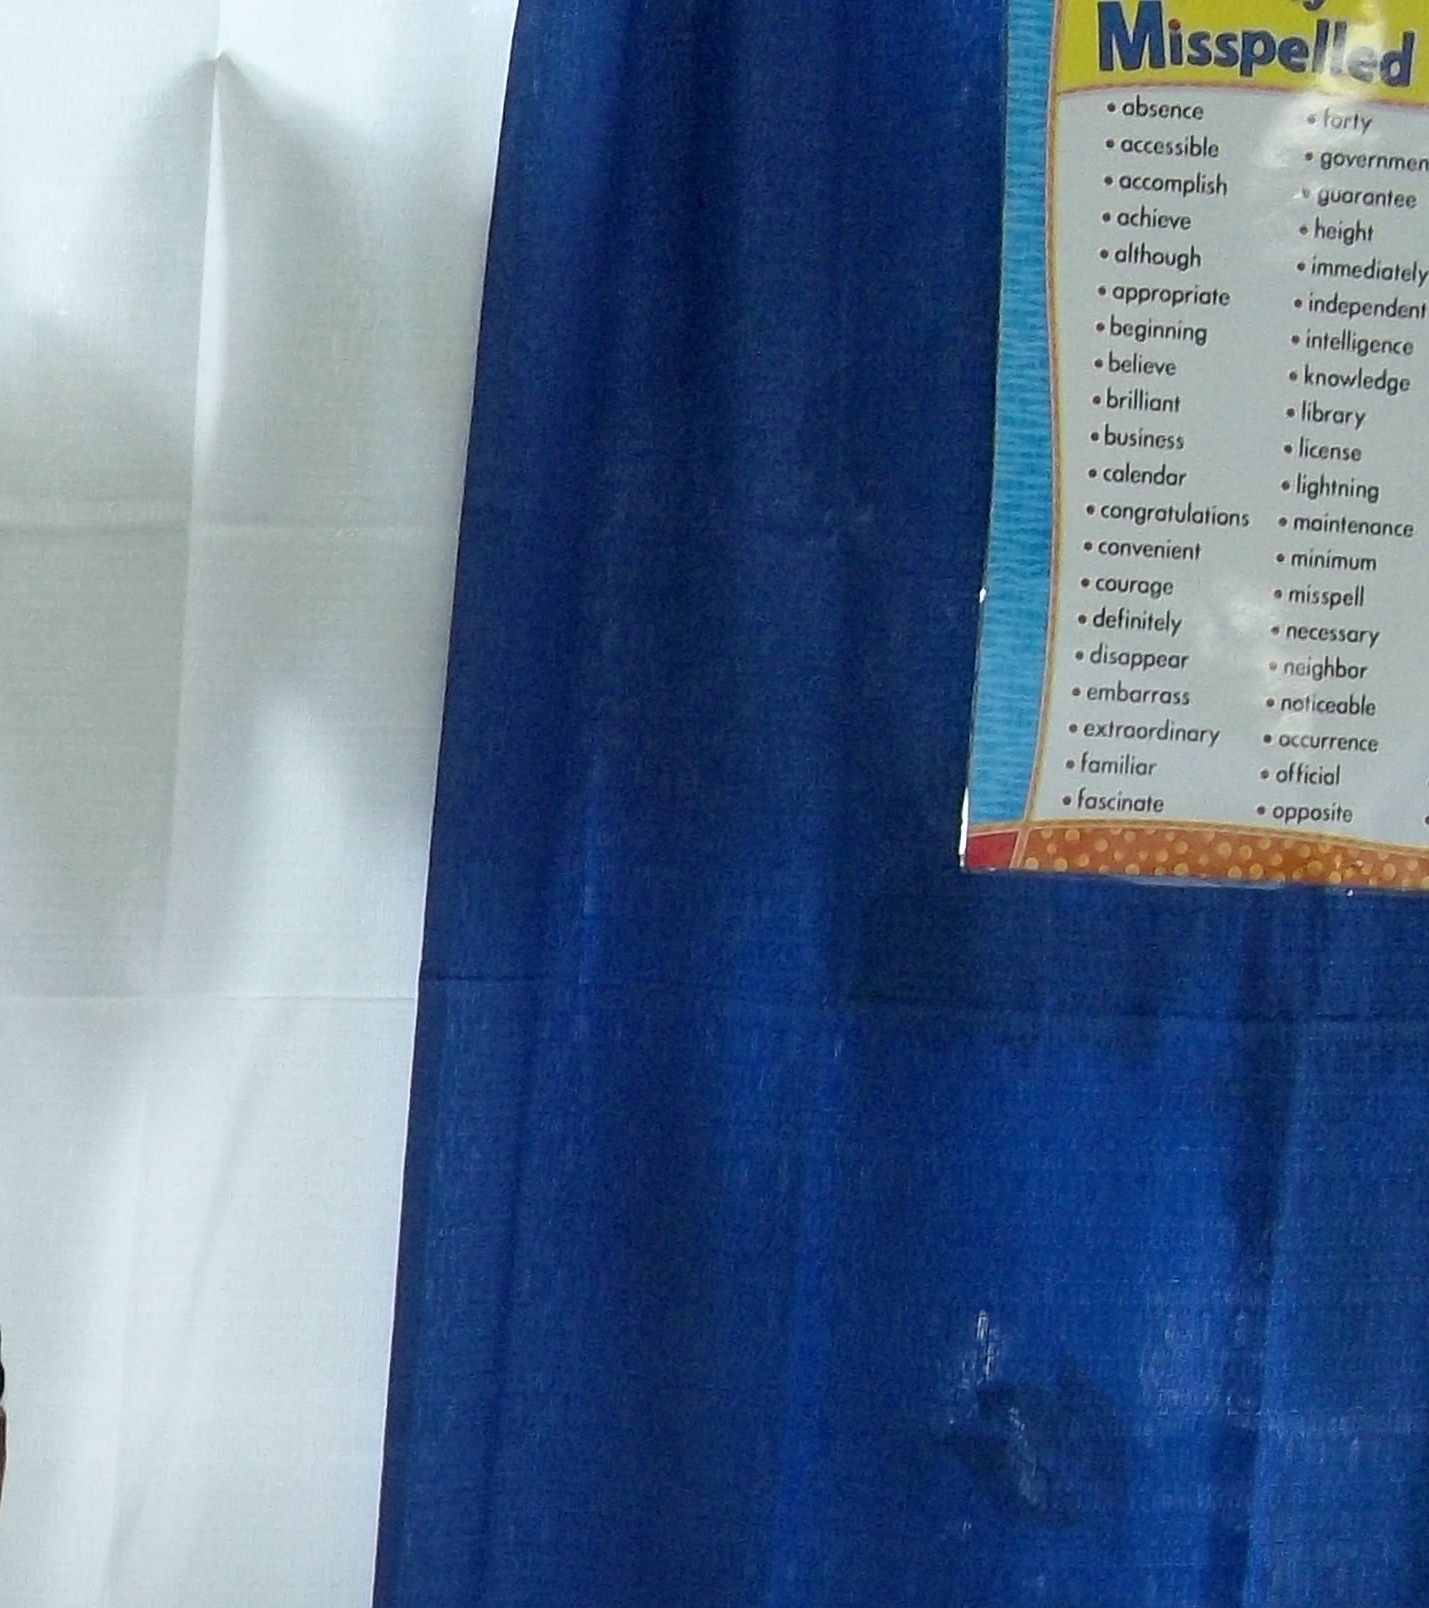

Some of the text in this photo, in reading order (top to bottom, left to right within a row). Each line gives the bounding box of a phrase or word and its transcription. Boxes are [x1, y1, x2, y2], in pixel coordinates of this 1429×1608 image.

[1098, 0, 1415, 87] Misspelled
[1122, 95, 1203, 120] absence
[1121, 133, 1219, 158] accessible
[1119, 170, 1227, 197] accomplish
[1117, 206, 1191, 230] achieve
[1315, 216, 1373, 246] height
[1115, 242, 1201, 271] although
[1113, 283, 1230, 307] appropriate
[1111, 314, 1207, 346] beginning
[1306, 329, 1413, 357] intelligence
[1109, 353, 1176, 376] believe
[1305, 365, 1410, 396] knowledge
[1107, 389, 1180, 412] brilliant
[1302, 402, 1365, 430] library
[1105, 425, 1184, 449] business
[1103, 466, 1186, 486] calendar
[1297, 470, 1379, 503] lightning
[1101, 500, 1249, 527] congratulations
[1294, 515, 1413, 537] maintenance
[1098, 539, 1200, 559] convenient
[1096, 576, 1173, 599] courage
[1078, 786, 1164, 813] fascinate
[1273, 802, 1352, 825] opposite
